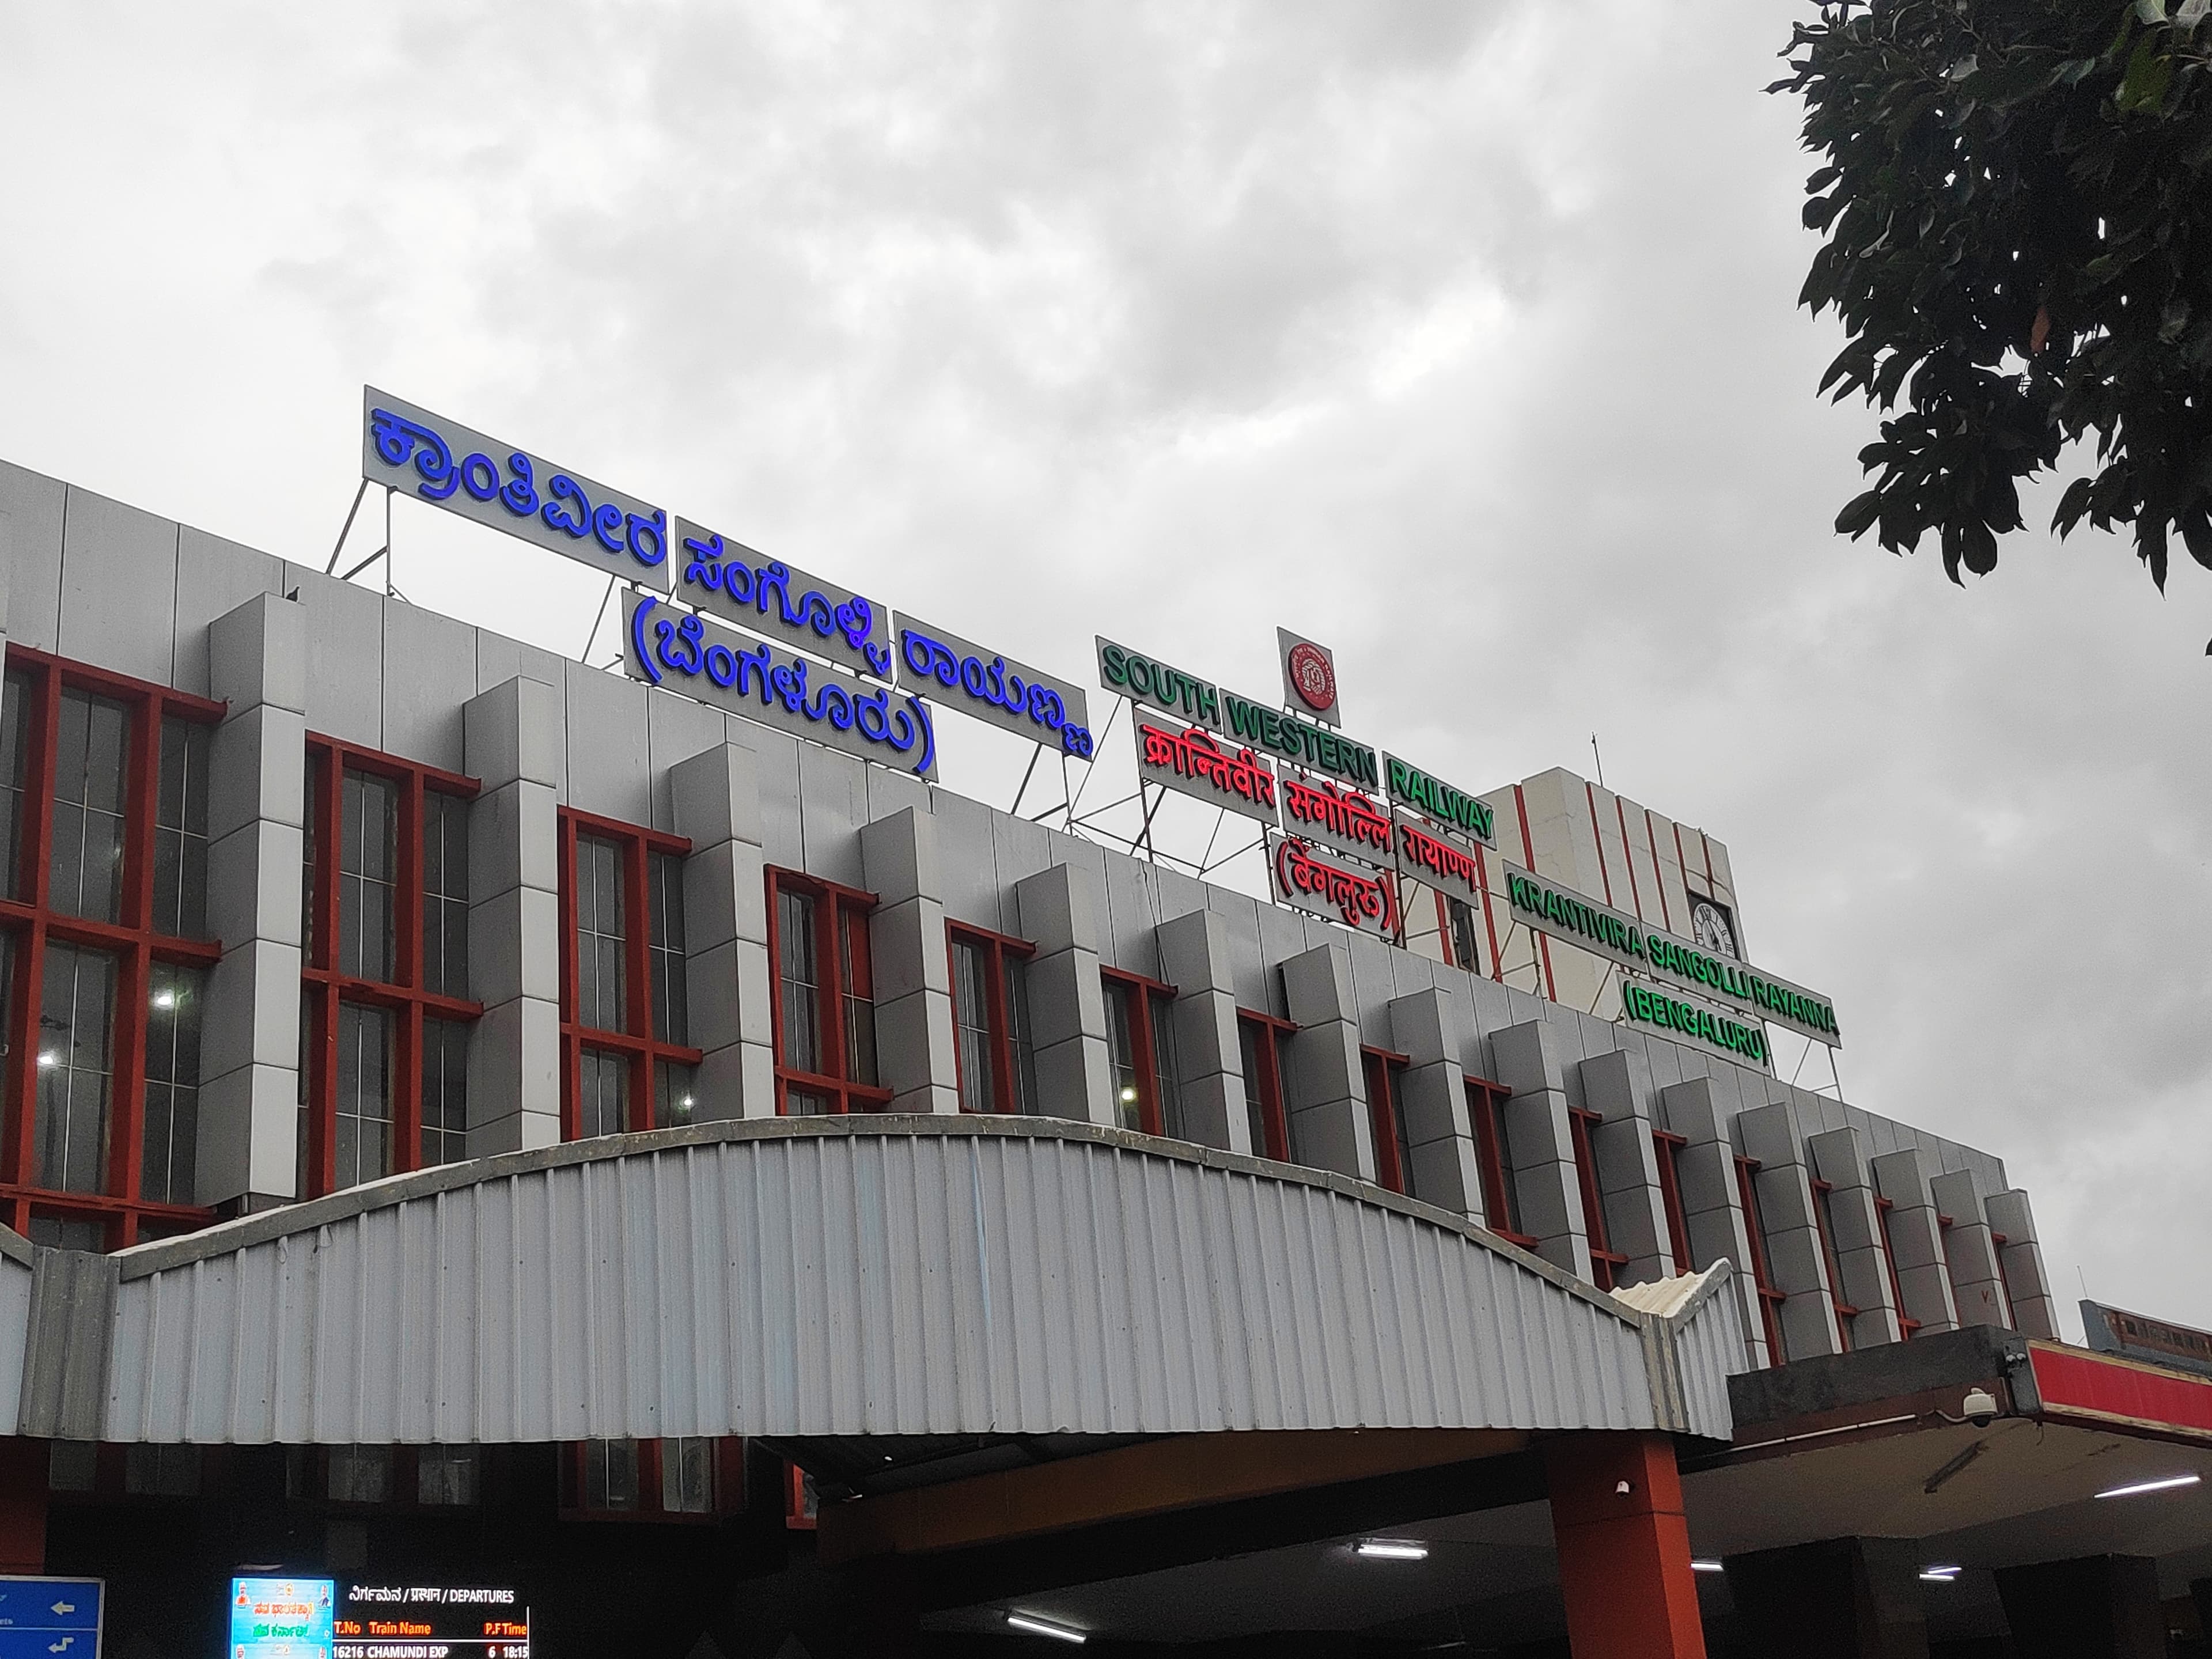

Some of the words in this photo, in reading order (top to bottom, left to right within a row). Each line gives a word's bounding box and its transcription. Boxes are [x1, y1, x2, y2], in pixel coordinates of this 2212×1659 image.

[371, 408, 666, 567] ಕ್ರಾಂತಿವೀರ
[683, 533, 891, 676] ಸಂಗೊಳ್ಳಿ
[901, 628, 1093, 756] ರಾಯಣ್ಣ
[631, 595, 934, 774] (ಬೆಂಗಳೂರು)
[1103, 645, 1221, 725] SOUTH
[1225, 695, 1379, 787] WESTERN
[1387, 759, 1493, 840] RAILWAY
[1139, 723, 1276, 809] क्रान्तिवीर
[1507, 872, 1646, 959] KRANTIVIRA
[1647, 934, 1751, 1001] SANGOLLI
[1750, 975, 1840, 1036] RAYANNA
[332, 1645, 364, 1658] 16216
[367, 1645, 427, 1659] CHAMUNDI
[429, 1646, 449, 1658] EXP
[488, 1646, 496, 1658] 6
[502, 1646, 528, 1659] 18:15
[334, 1621, 361, 1634] T.No
[369, 1621, 397, 1635] Train
[399, 1621, 431, 1635] Name
[485, 1623, 501, 1635] P.F
[502, 1622, 527, 1635] Time
[349, 1585, 402, 1601] ನಿರ್ಗಮನ
[449, 1589, 514, 1604] DEPARTURES
